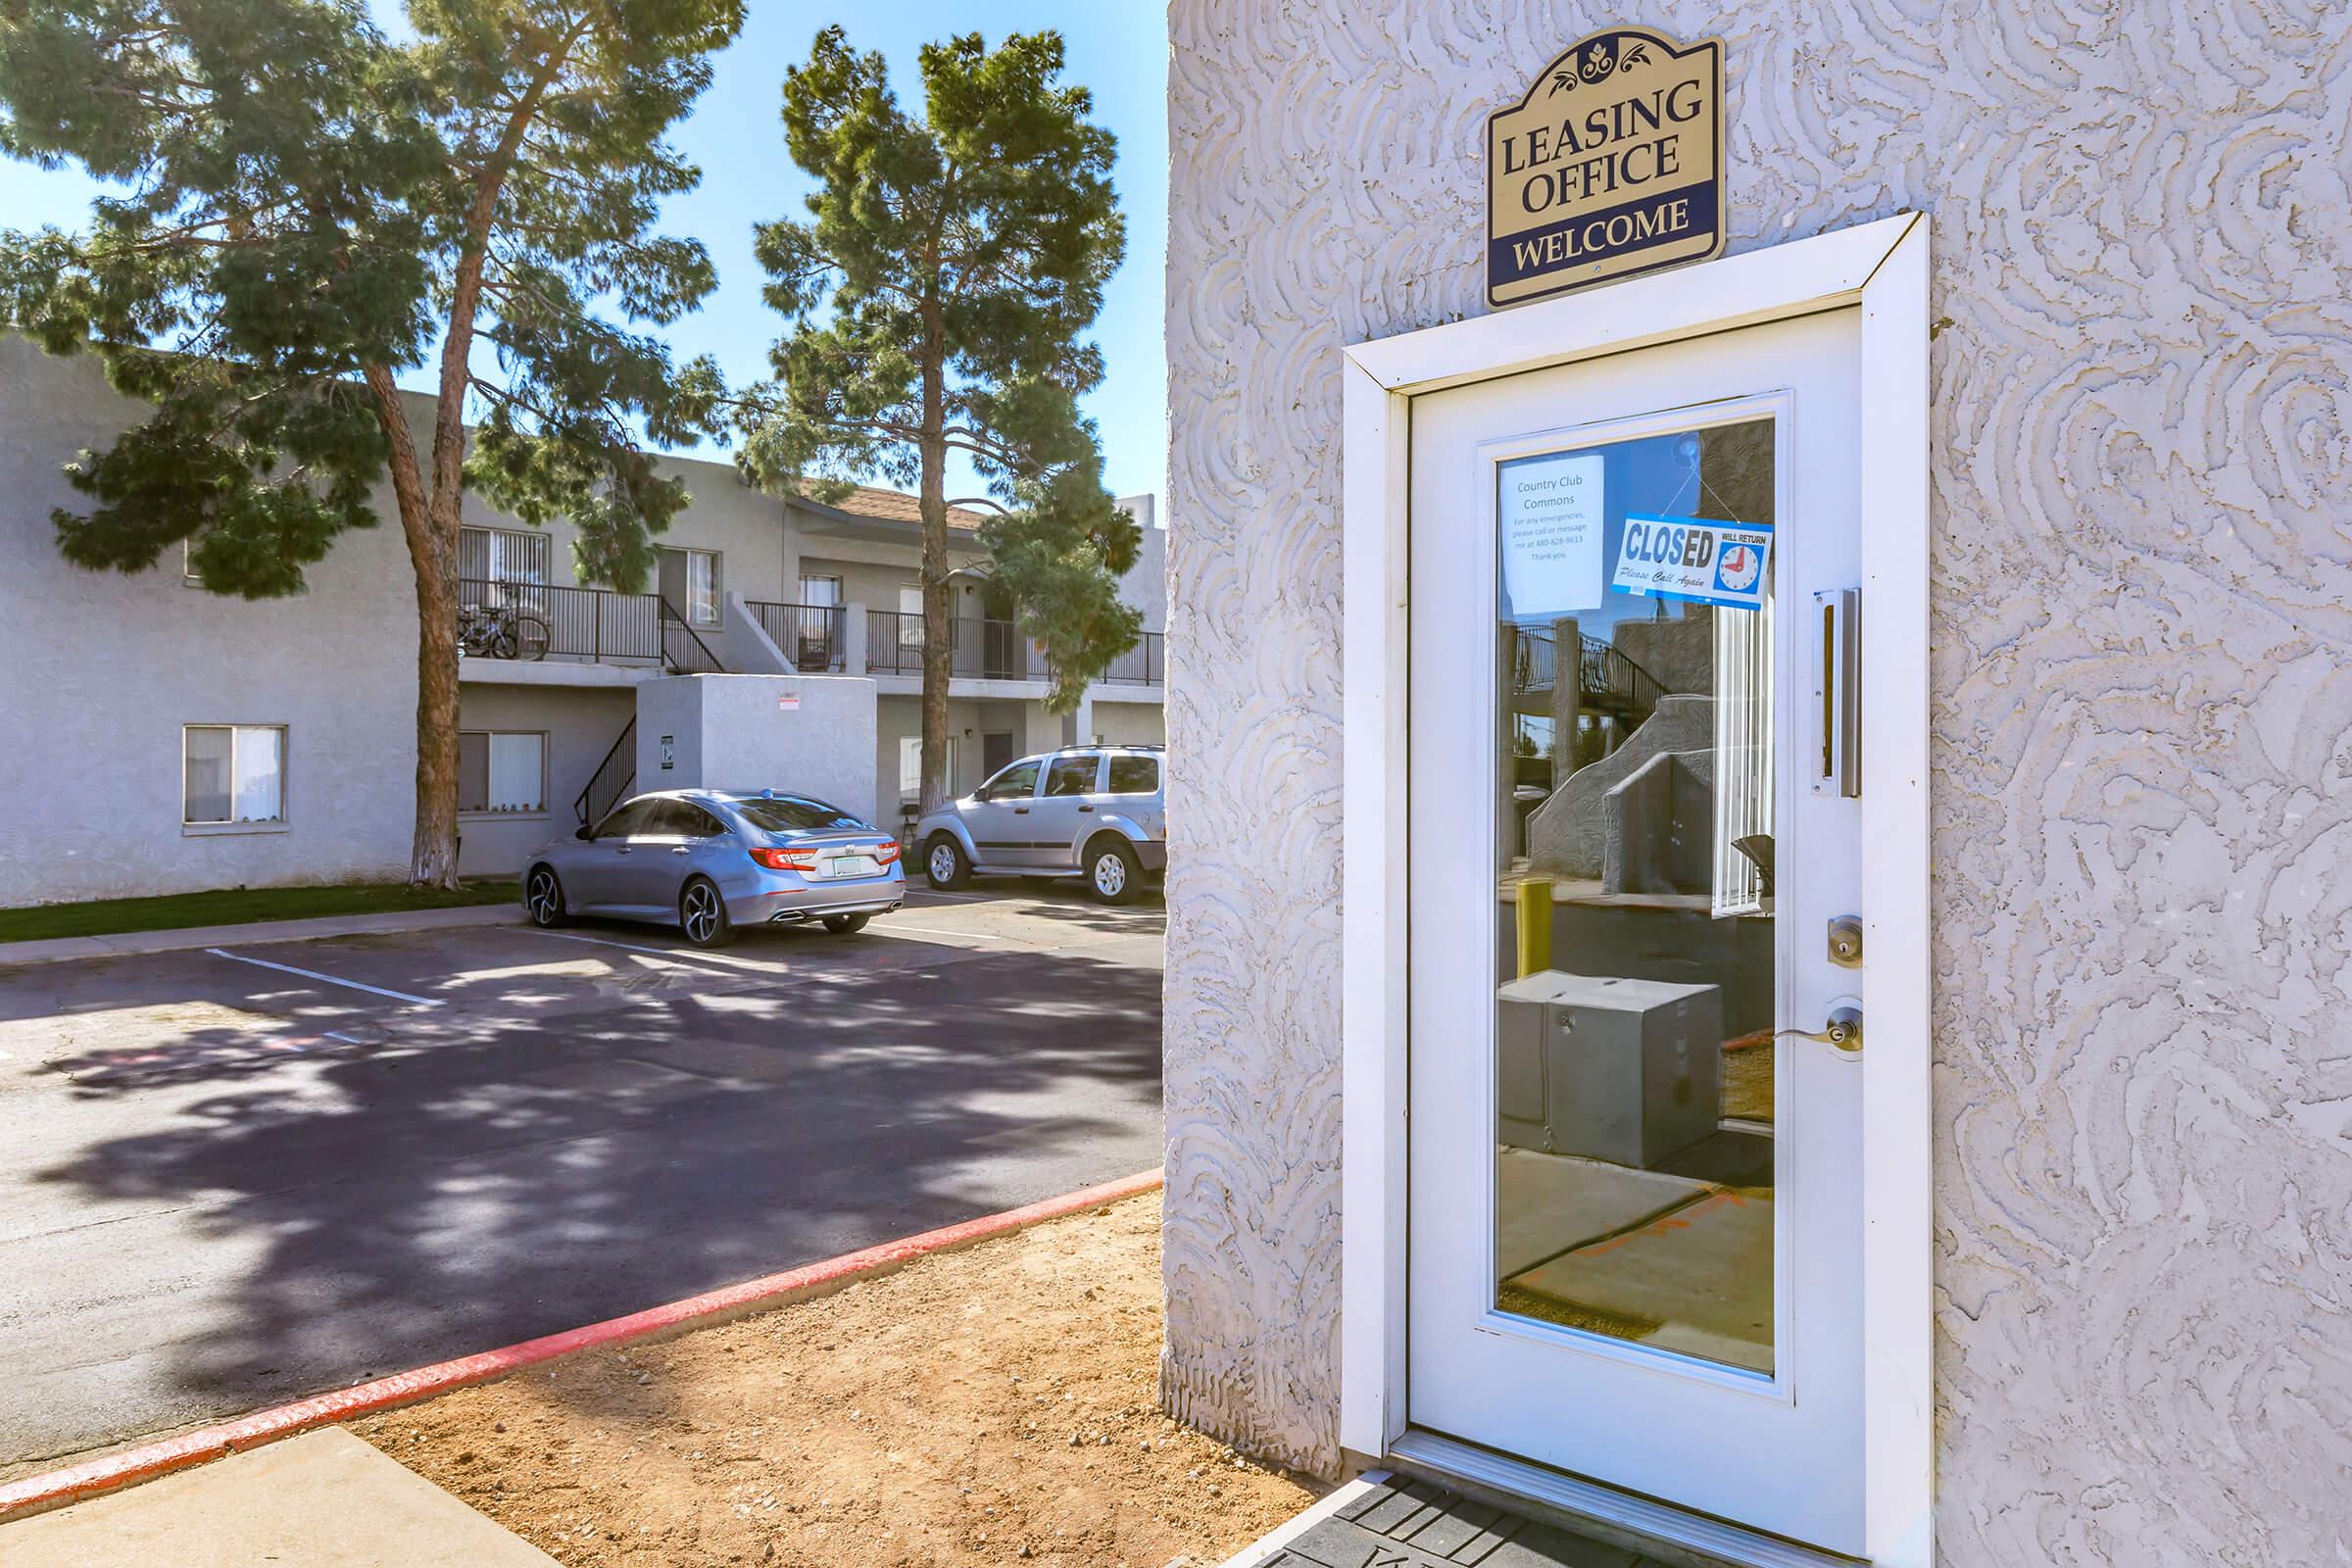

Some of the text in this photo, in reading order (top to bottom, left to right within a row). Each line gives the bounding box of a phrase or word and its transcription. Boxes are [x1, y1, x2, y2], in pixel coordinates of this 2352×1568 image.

[1502, 78, 1702, 175] LEASING
[1522, 134, 1680, 214] OFFICE
[1512, 198, 1689, 271] WELCOME
[1518, 474, 1583, 493] Country Club
[1524, 495, 1575, 510] Commons
[1513, 517, 1525, 526] For
[1512, 530, 1534, 539] please
[1535, 526, 1546, 535] call
[1556, 524, 1588, 533] message
[1722, 532, 1766, 545] WILL RETURN
[1527, 540, 1535, 549] at
[1627, 523, 1714, 568] CLOSED
[1531, 552, 1566, 562] Thank you
[1620, 566, 1705, 587] Please Call Again
